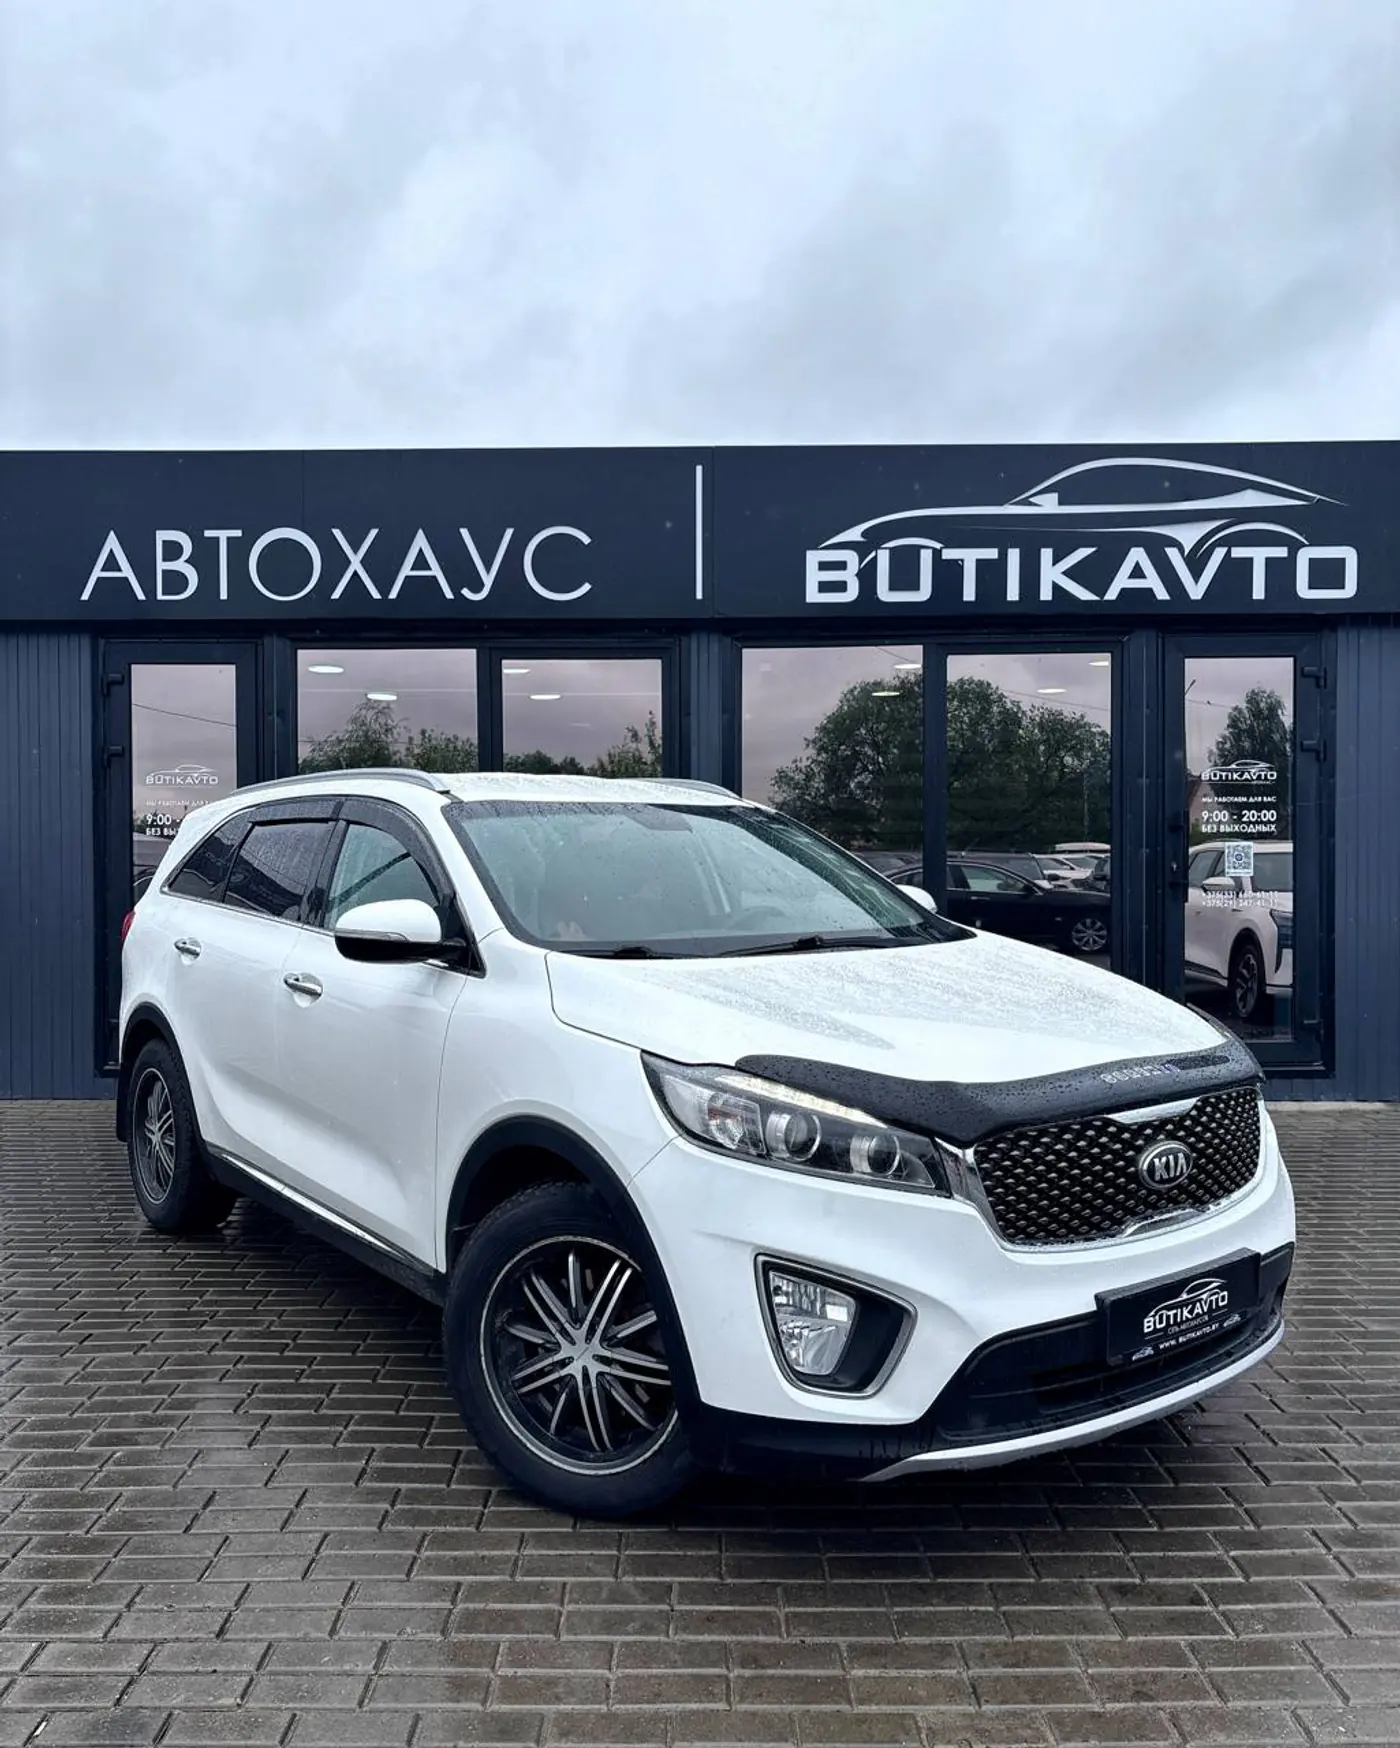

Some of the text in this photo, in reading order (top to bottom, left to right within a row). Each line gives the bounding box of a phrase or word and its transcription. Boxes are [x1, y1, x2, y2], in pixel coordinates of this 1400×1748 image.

[80, 525, 592, 601] АВТОХАУС
[805, 546, 1358, 603] BUTIKAVTO
[146, 775, 219, 785] BUTIKAVTO
[1201, 771, 1277, 780] BUTIKAVTO
[146, 814, 172, 825] 9:00
[1201, 810, 1229, 822] 9:00
[1241, 810, 1277, 822] 20:00
[146, 828, 161, 836] БЕЗ
[1201, 823, 1277, 834] БЕЗ ВЫХОДНЫХ
[1152, 1152, 1187, 1182] KIA
[1143, 1291, 1228, 1333] BUTIKAVTO
